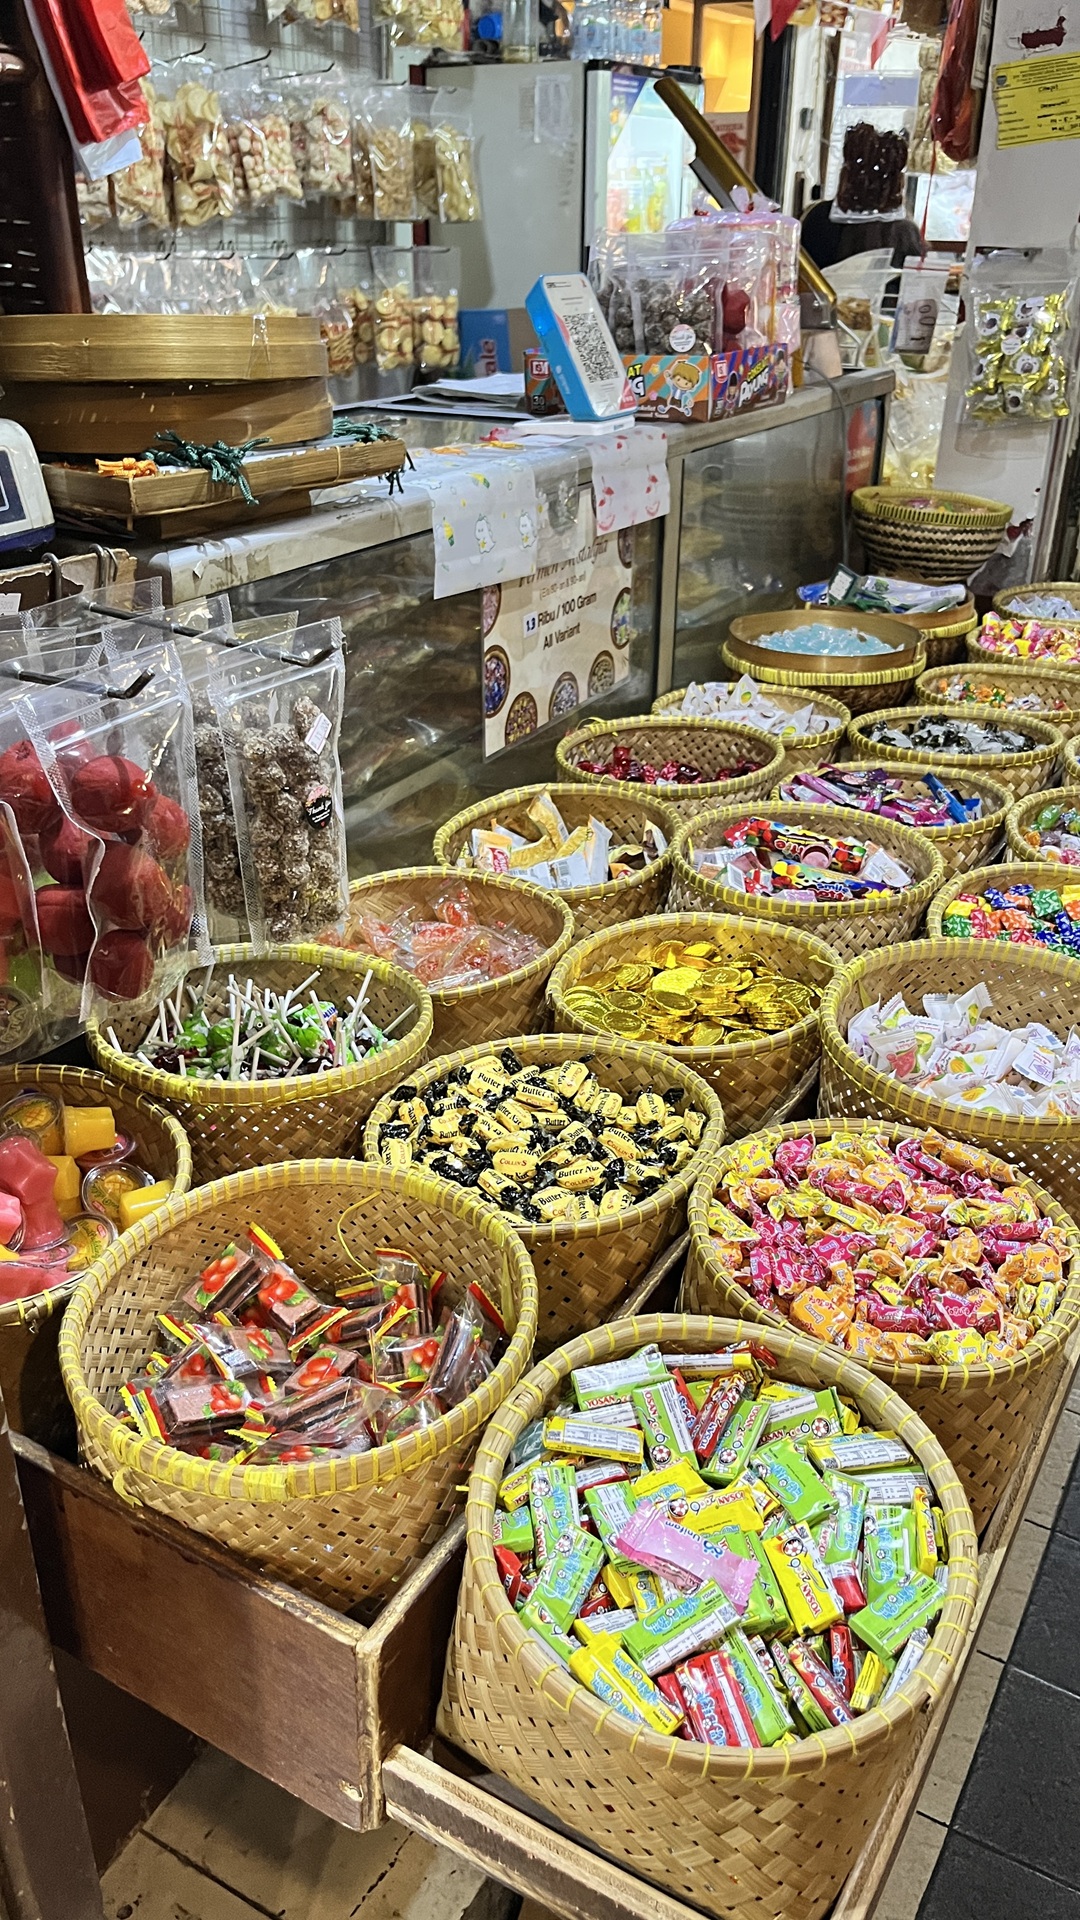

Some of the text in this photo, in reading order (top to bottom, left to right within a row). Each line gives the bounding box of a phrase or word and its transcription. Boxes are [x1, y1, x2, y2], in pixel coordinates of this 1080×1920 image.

[538, 611, 555, 627] Ribu
[562, 599, 575, 616] 100
[577, 593, 597, 610] Gram
[543, 622, 580, 650] All Variant
[817, 882, 849, 894] Smile
[478, 1072, 501, 1089] Butter
[557, 1168, 584, 1179] Butter
[539, 1193, 561, 1206] Butter
[586, 1396, 615, 1407] YOSAN
[745, 1405, 761, 1428] YOSAN
[700, 1422, 717, 1448] YOSAN
[718, 1491, 745, 1504] YOSAN
[665, 1521, 701, 1543] Unifam
[536, 1527, 546, 1560] YOSAN
[802, 1584, 821, 1615] YOSAN
[772, 1645, 786, 1665] YOSAN
